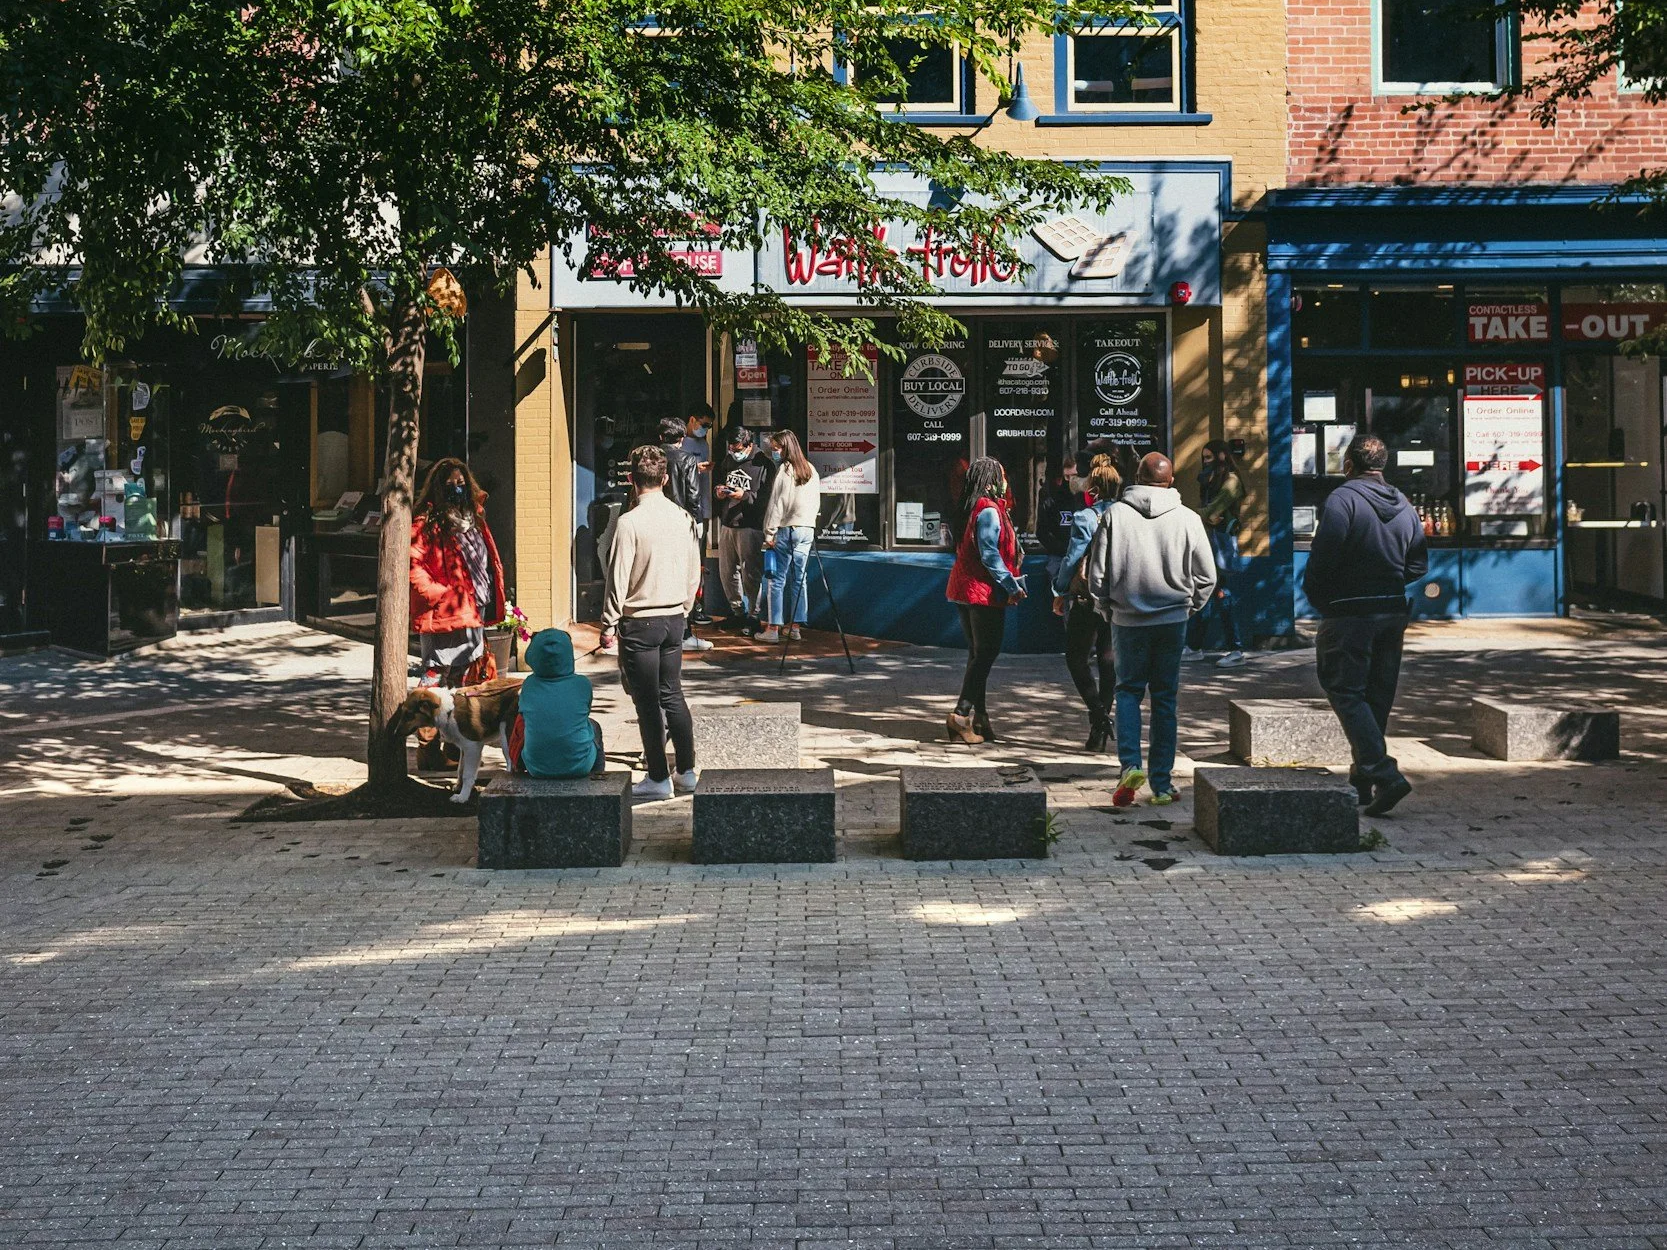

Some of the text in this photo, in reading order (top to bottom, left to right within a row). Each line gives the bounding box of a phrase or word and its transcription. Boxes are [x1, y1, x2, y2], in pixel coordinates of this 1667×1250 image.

[1469, 305, 1537, 314] CONTACTLESS
[1469, 315, 1649, 339] TAKE -OUT
[900, 342, 919, 350] NOW
[989, 340, 1023, 349] DELIVERY
[1095, 339, 1140, 347] TAKEOUT
[908, 357, 958, 378] CURBSIDE
[739, 369, 766, 380] Open
[1465, 367, 1542, 380] PICK-UP
[904, 382, 962, 390] BUY LOCAL
[998, 379, 1049, 387] ithacatogo.com
[908, 394, 957, 414] DELIVERY
[1100, 408, 1138, 416] Call Ahead
[1090, 418, 1147, 427] 607-319-0999
[907, 433, 961, 441] 607-319-0999
[823, 464, 863, 472] Thank You
[1479, 460, 1519, 471] HERE
